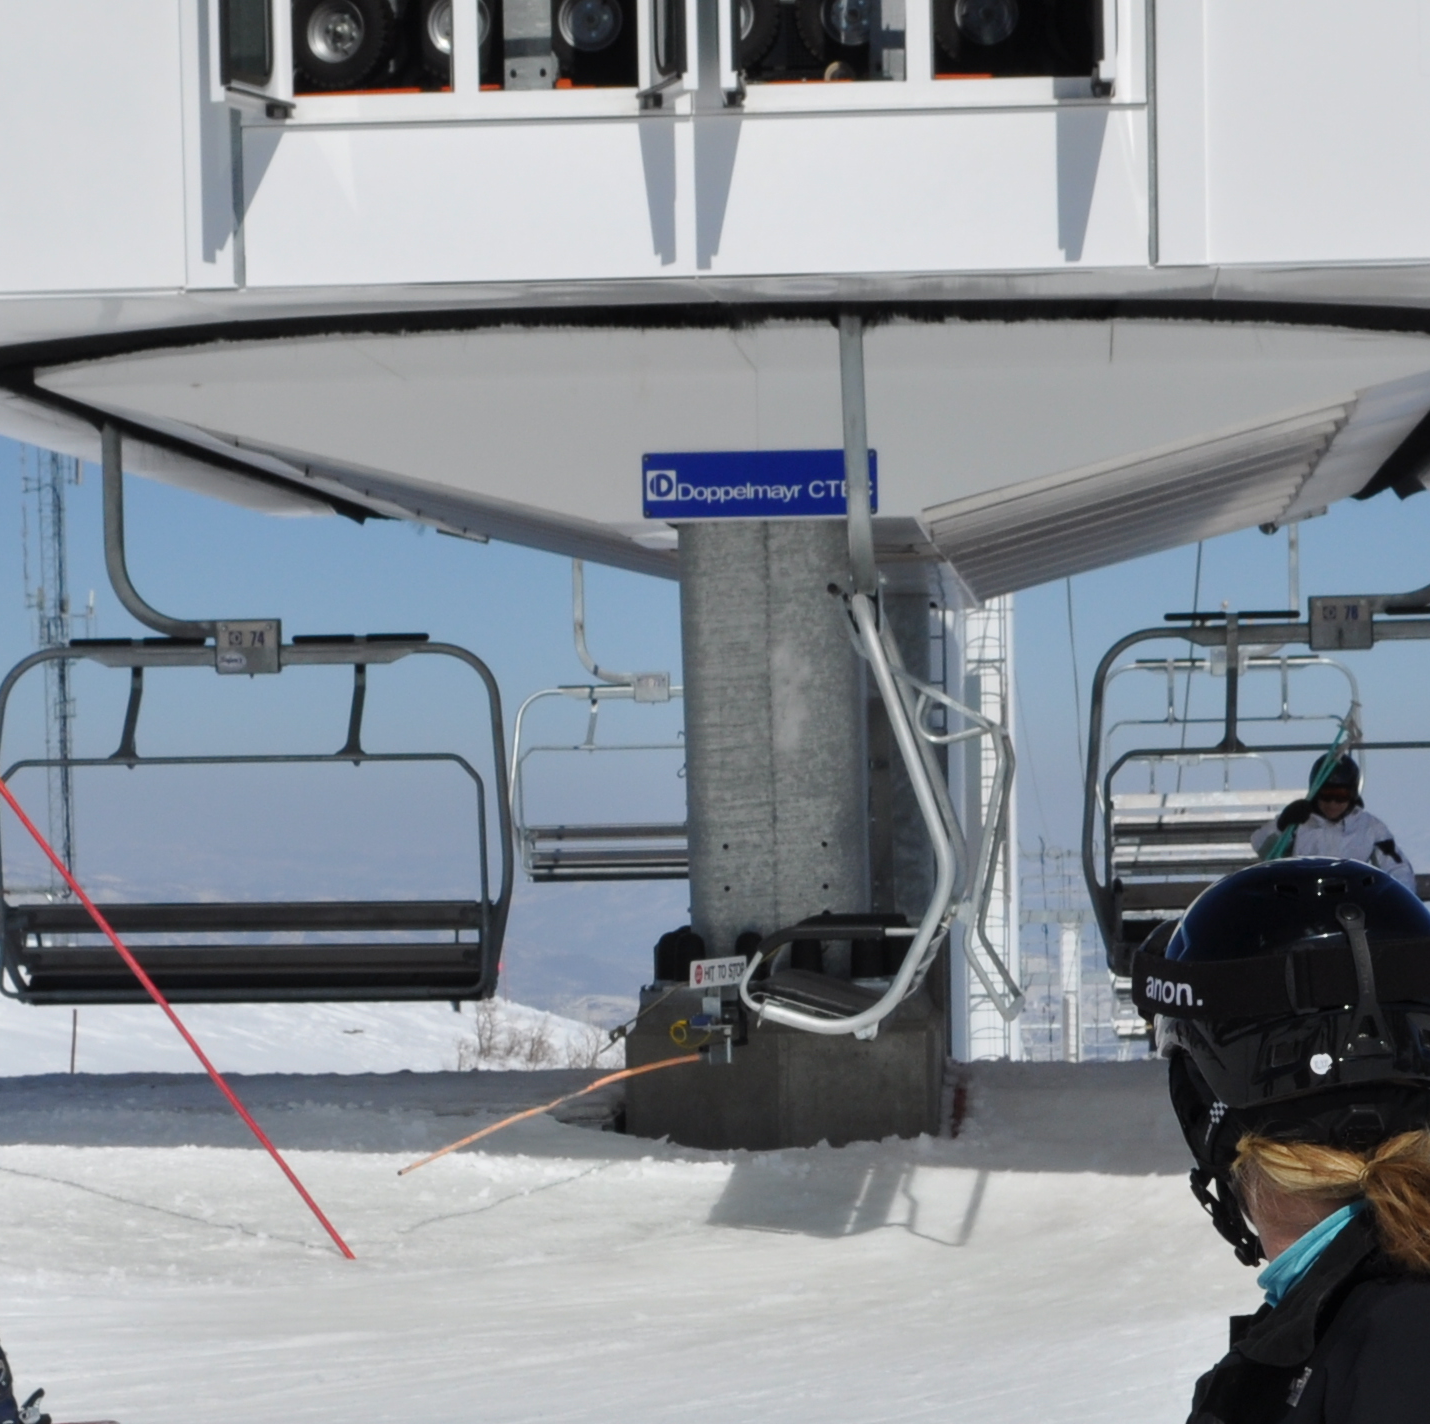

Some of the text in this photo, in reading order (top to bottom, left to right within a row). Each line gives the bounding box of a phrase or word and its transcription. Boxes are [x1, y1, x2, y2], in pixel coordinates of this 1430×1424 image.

[678, 482, 802, 503] Doppelmayr
[704, 966, 716, 982] HIT
[718, 964, 727, 979] TO
